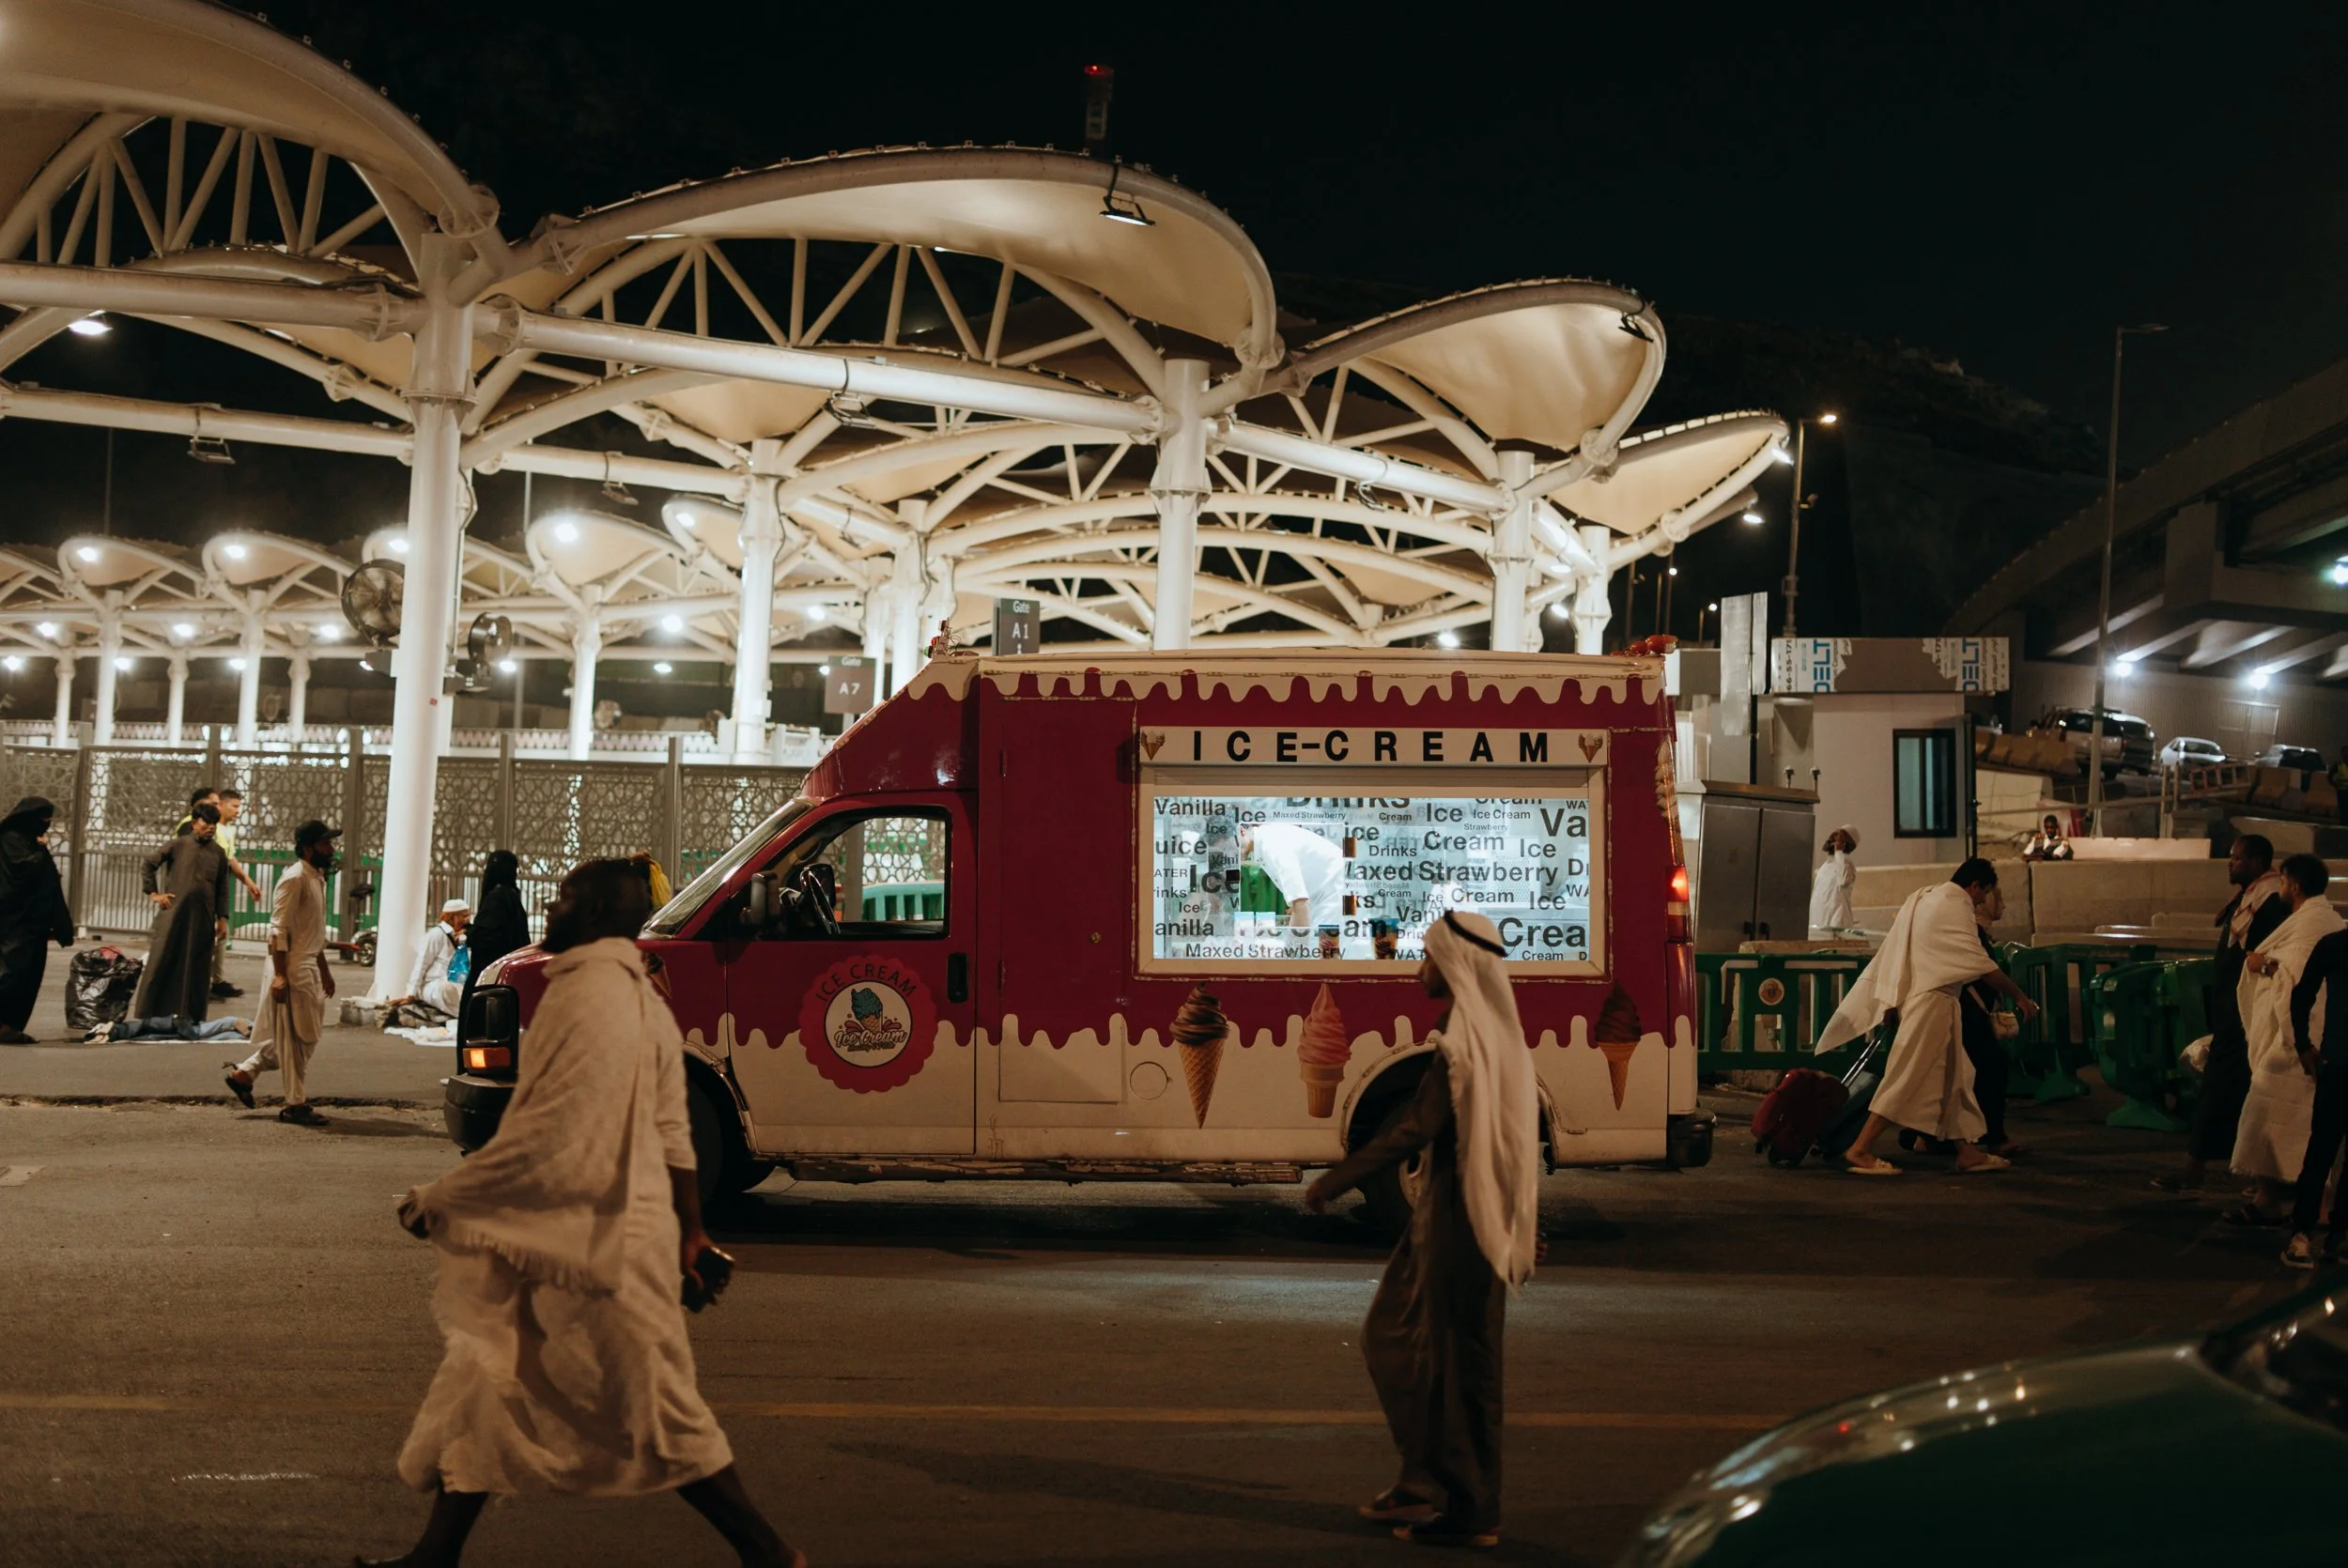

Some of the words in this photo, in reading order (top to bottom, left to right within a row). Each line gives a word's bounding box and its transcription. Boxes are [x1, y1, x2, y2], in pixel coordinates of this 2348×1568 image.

[1013, 600, 1030, 614] Gate
[1193, 730, 1549, 762] ICE-CREAM
[1154, 799, 1226, 816] Vanilla
[1566, 800, 1588, 809] WA
[1234, 807, 1266, 823] Ice
[1302, 811, 1346, 821] Strawberry
[1379, 812, 1412, 822] Cream
[1427, 803, 1462, 822] Ice
[1474, 809, 1491, 819] Ice
[1493, 809, 1531, 819] Cream
[1206, 823, 1228, 834] Ice
[1540, 808, 1586, 838] Va
[1424, 831, 1505, 851] Cream
[1520, 838, 1556, 858] Ice
[1369, 844, 1417, 857] Drinks
[1419, 861, 1558, 886] Strawberry
[1153, 886, 1187, 898] inks
[1379, 888, 1412, 898] Cream
[1423, 891, 1444, 902] Ice
[1451, 888, 1515, 902] Cream
[1179, 901, 1200, 913] Ice
[1529, 890, 1566, 911] Ice
[1498, 916, 1586, 947] Crea
[1186, 943, 1244, 958] Maxed
[1248, 944, 1346, 959] Strawberry
[1522, 949, 1564, 961] Cream
[815, 973, 845, 1002] ICE
[849, 963, 917, 998] CREAM
